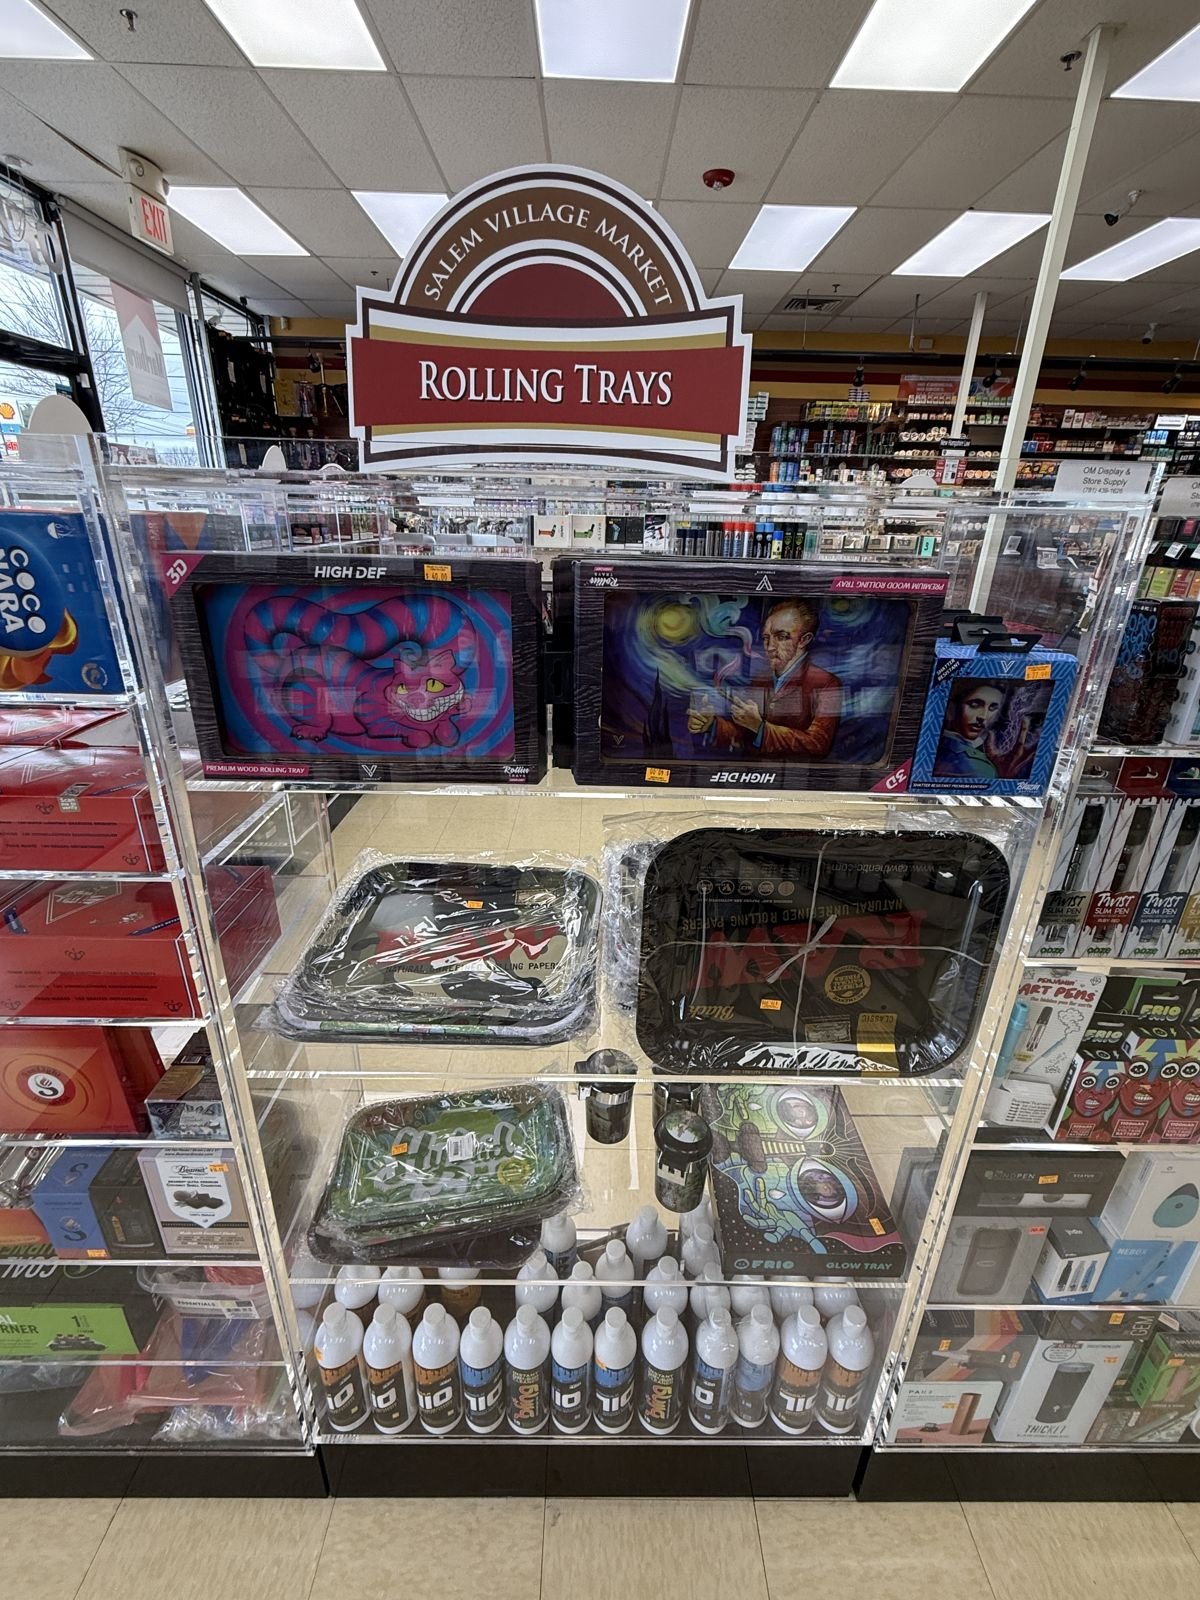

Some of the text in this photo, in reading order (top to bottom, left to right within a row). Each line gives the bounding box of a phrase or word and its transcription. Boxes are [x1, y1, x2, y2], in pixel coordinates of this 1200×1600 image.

[140, 196, 167, 244] EXIT
[424, 203, 673, 306] SALEM VILLAGE MARKET
[419, 360, 673, 406] ROLLING TRAYS
[1083, 466, 1096, 474] OM
[1098, 467, 1124, 476] Display
[1103, 478, 1128, 486] Supply
[166, 558, 187, 585] 3D
[314, 566, 388, 579] HIGH DEF
[10, 548, 46, 634] COCO
[836, 580, 945, 591] PREMIUM WOOD ROLLING TRAY
[260, 766, 287, 774] ROLLING
[288, 767, 305, 775] TRAY
[710, 772, 776, 784] HIGH DEF
[884, 768, 907, 790] 3D
[853, 898, 903, 914] NATURAL
[682, 917, 724, 931] PAPERS
[731, 909, 777, 927] ROLLING
[688, 909, 927, 991] RAW
[386, 962, 561, 974] NATURAL PAPERS
[1018, 983, 1095, 1003] ART PENS
[687, 1004, 736, 1021] Black
[861, 1014, 894, 1023] CLASSIC
[1139, 1004, 1182, 1019] FRIO
[1083, 1029, 1123, 1042] FRIO
[751, 1259, 794, 1270] FRIO
[825, 1261, 893, 1271] GLOW TRAY
[1130, 1315, 1156, 1337] GEM
